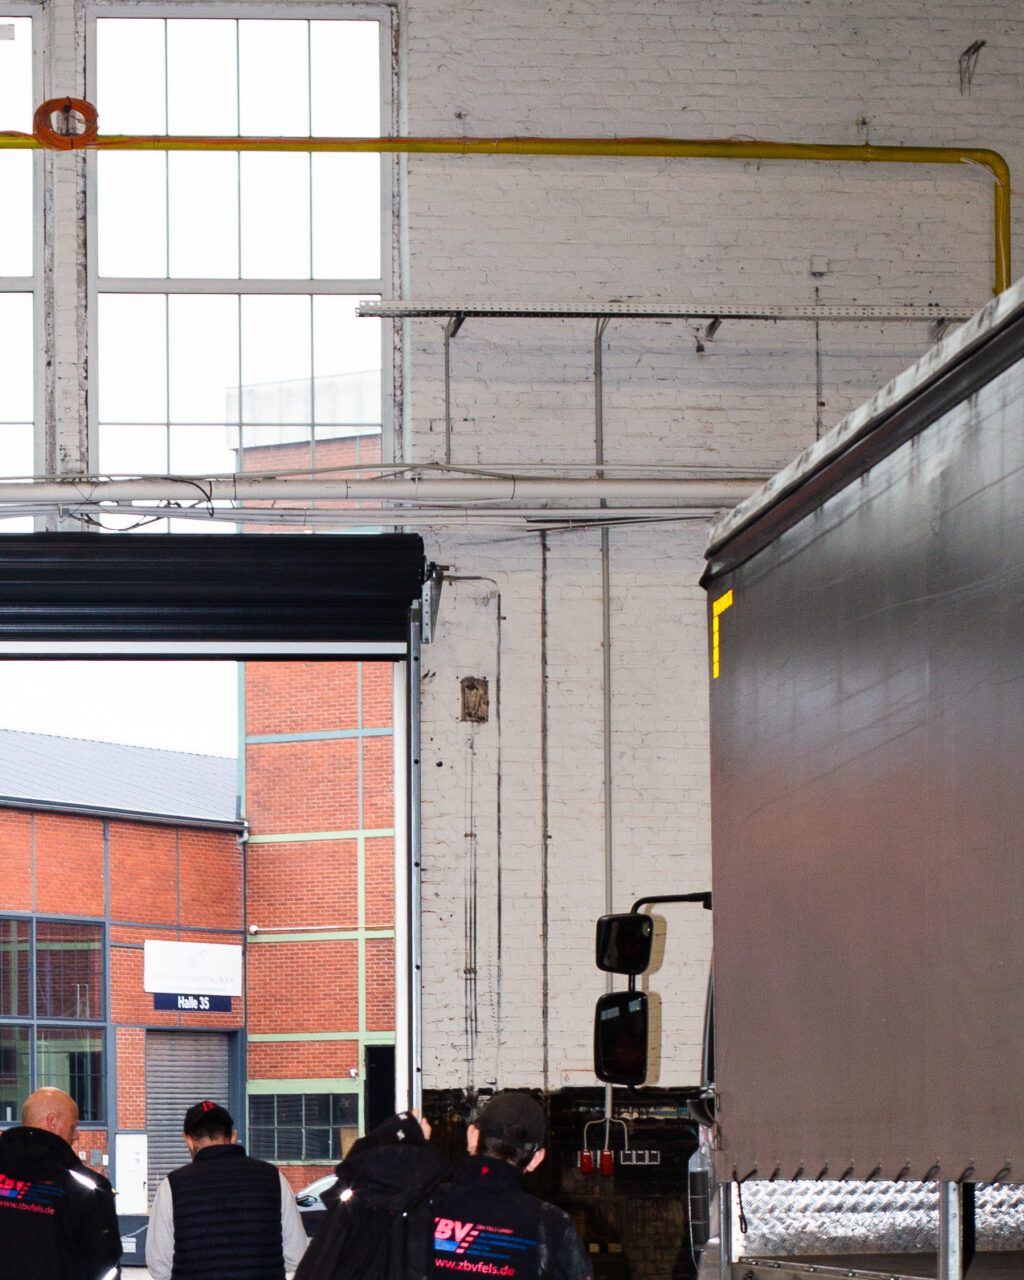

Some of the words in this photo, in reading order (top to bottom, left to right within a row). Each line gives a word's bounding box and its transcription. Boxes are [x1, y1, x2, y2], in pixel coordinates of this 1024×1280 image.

[177, 995, 198, 1009] Halle
[199, 996, 210, 1009] 35
[434, 1217, 474, 1243] BV
